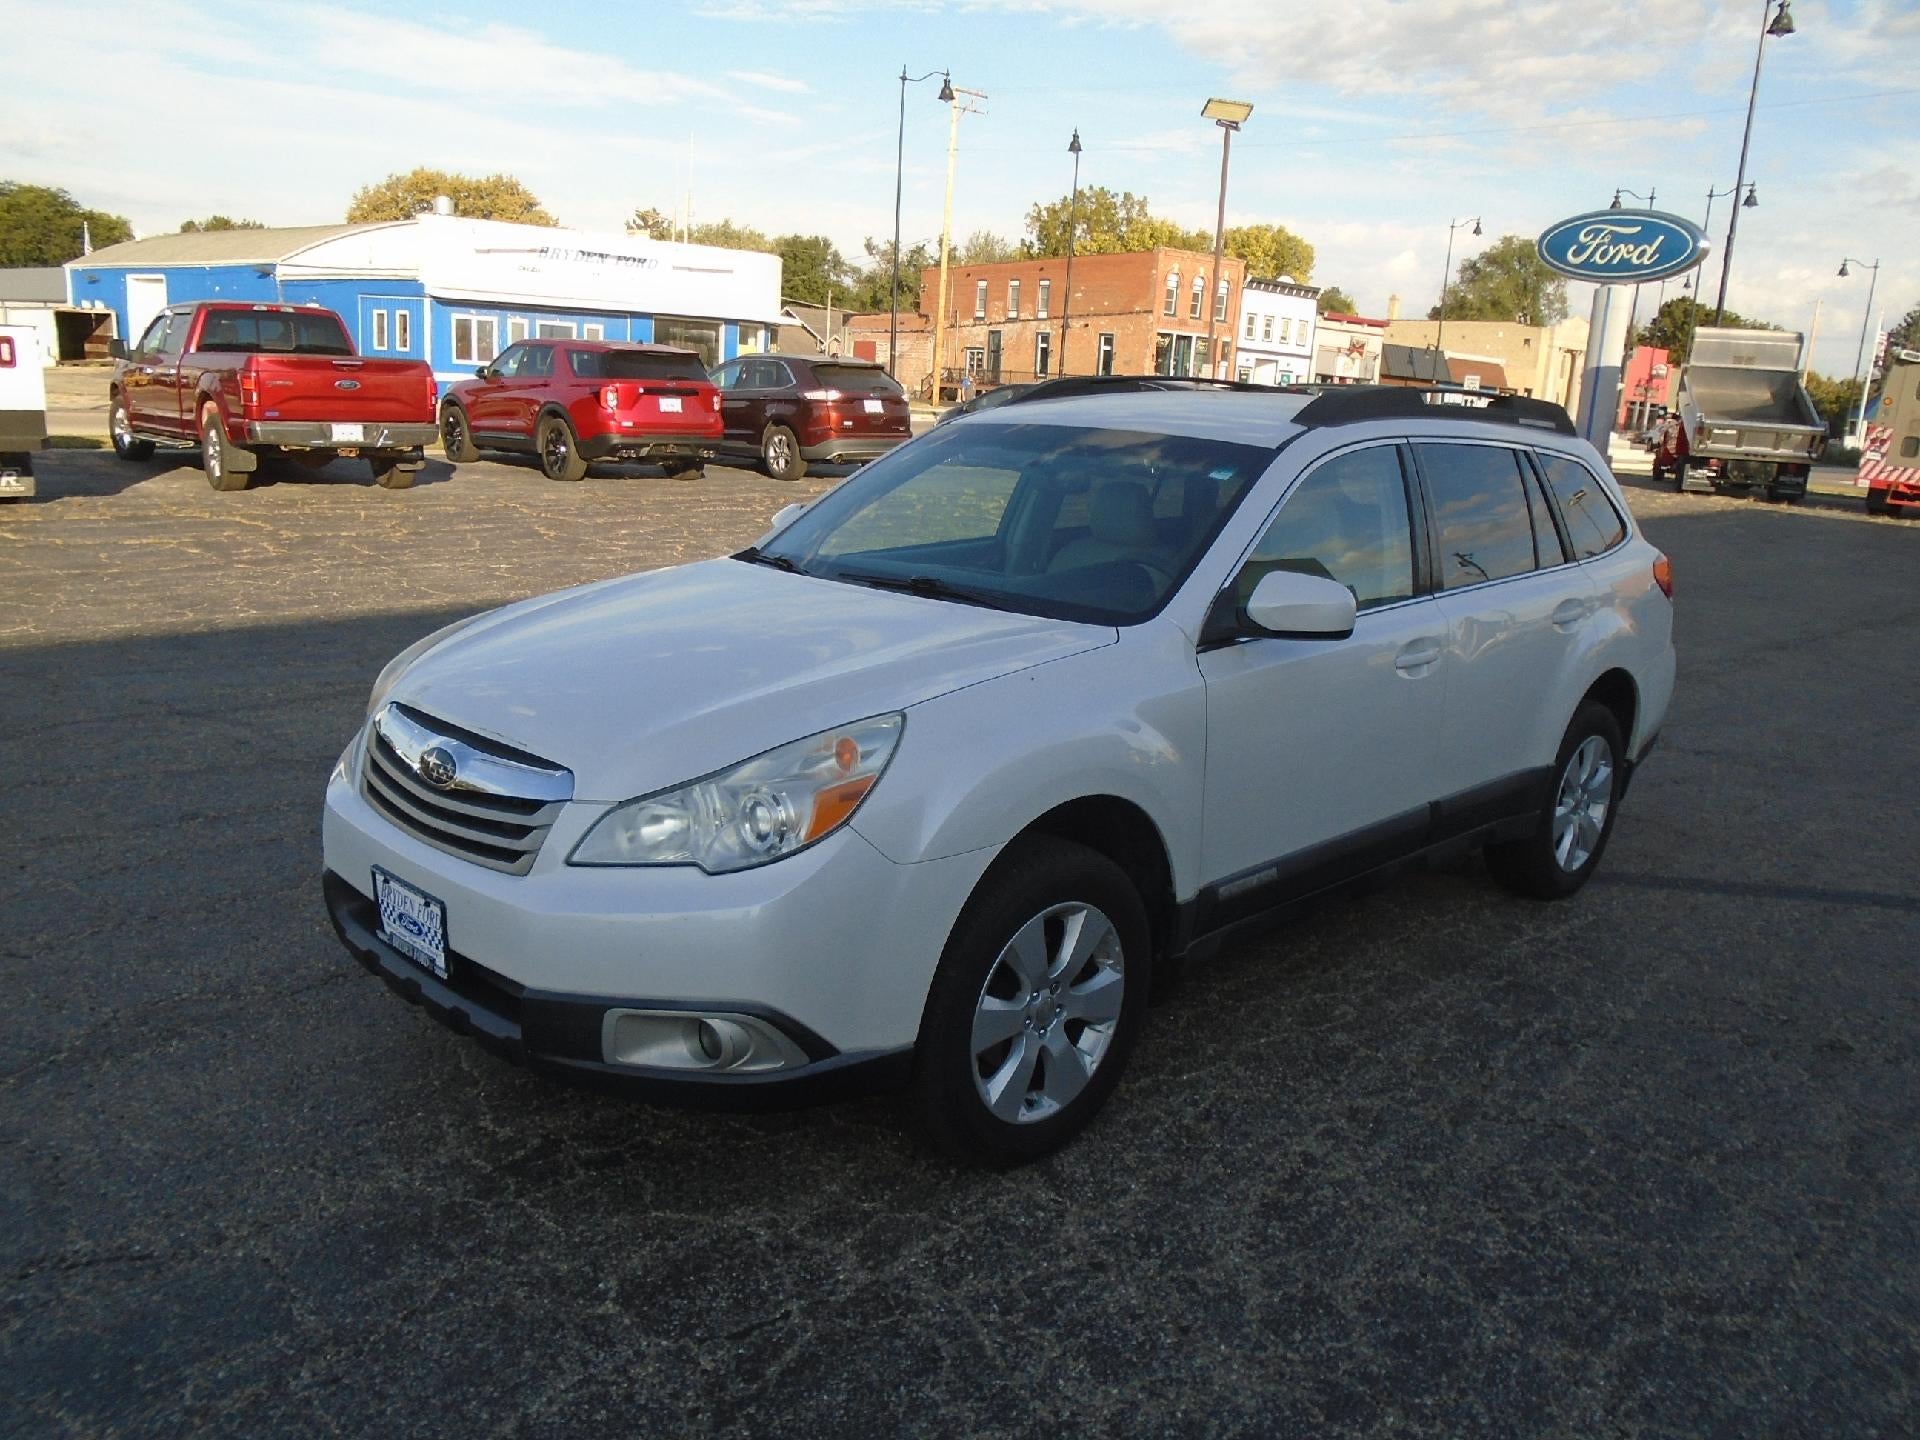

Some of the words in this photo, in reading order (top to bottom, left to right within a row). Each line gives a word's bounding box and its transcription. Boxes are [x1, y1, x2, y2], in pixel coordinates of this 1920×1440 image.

[539, 247, 606, 265] BRYDEN
[615, 254, 659, 270] FORD
[1566, 224, 1665, 265] Ford
